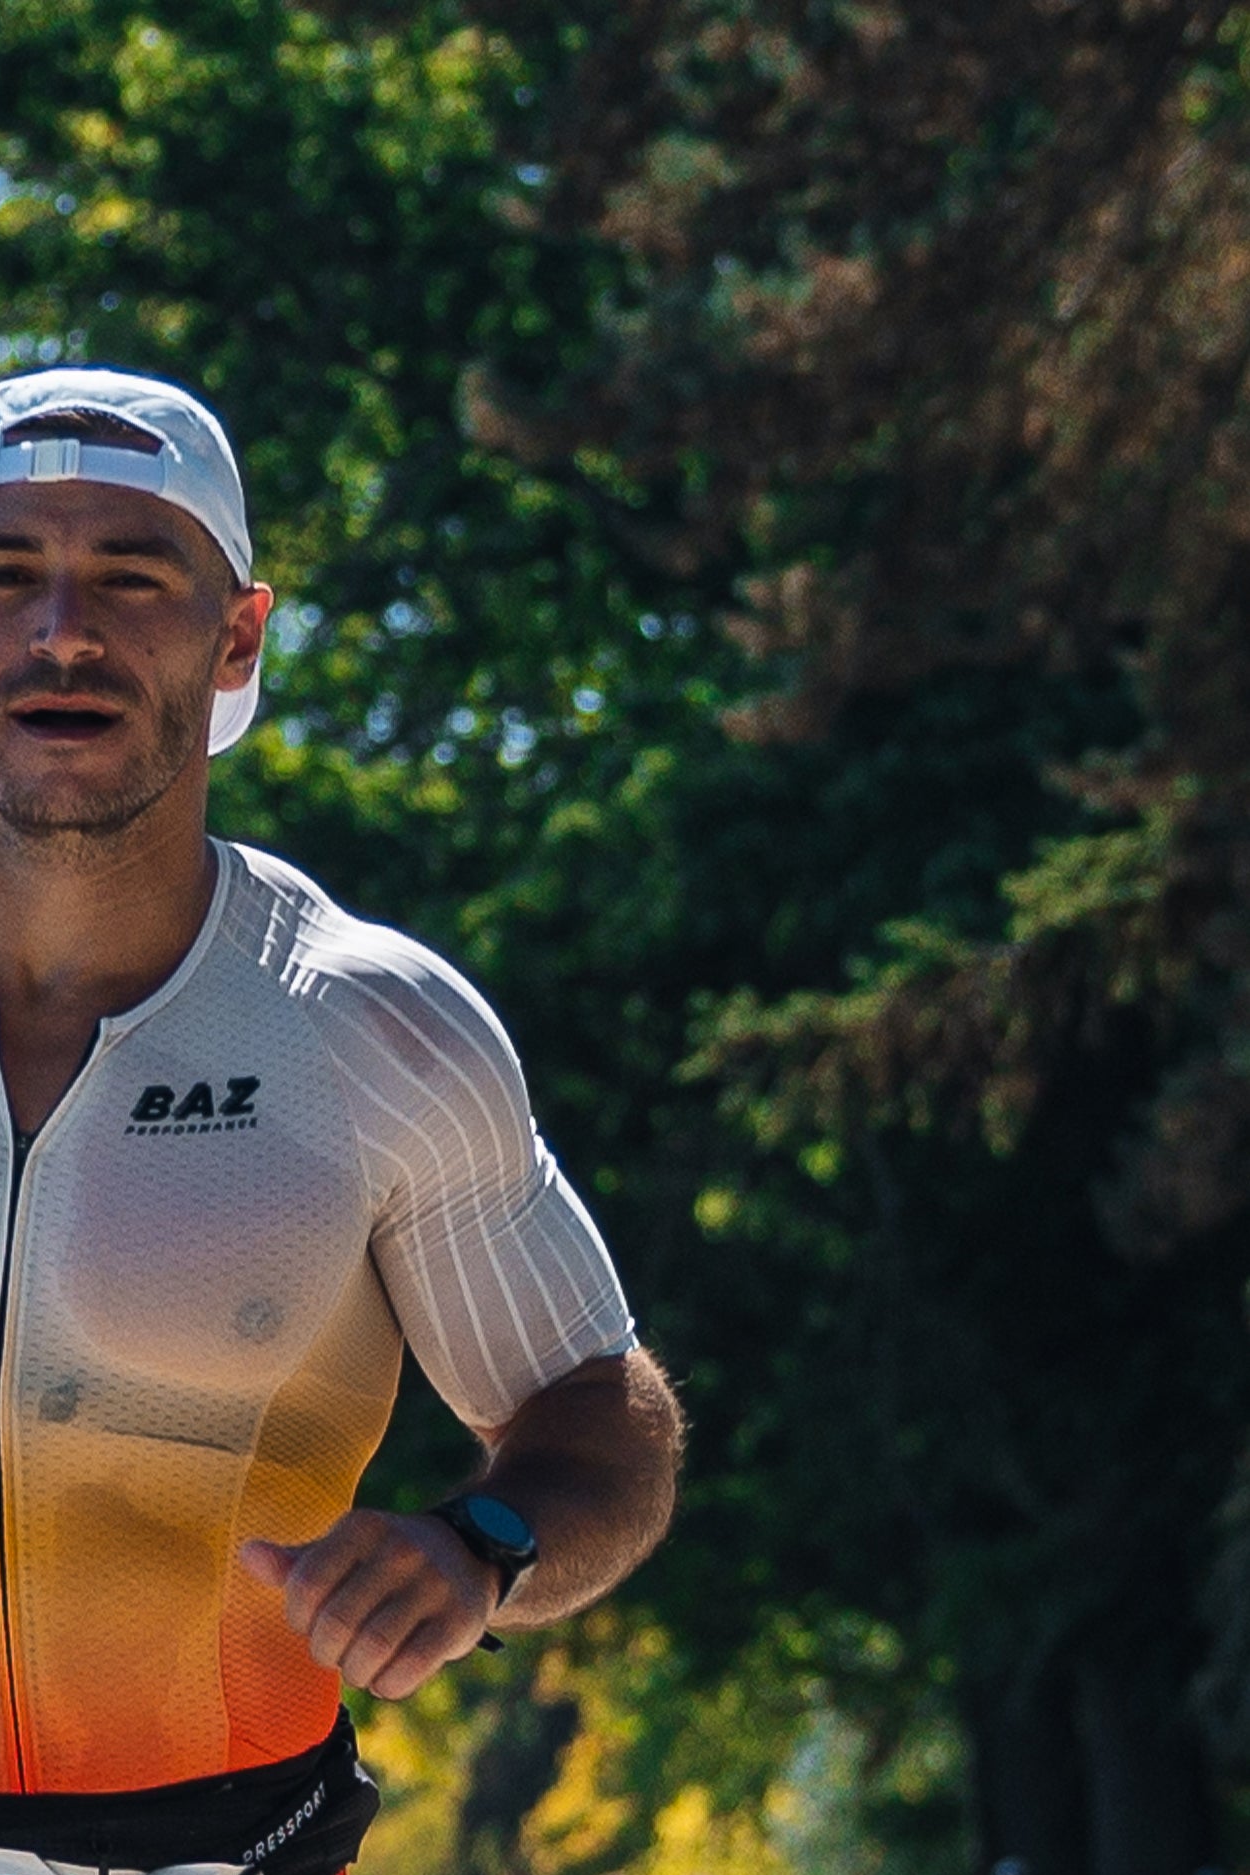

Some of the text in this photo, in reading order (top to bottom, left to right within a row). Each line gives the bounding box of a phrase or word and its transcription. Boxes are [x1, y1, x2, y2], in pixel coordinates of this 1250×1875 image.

[130, 1076, 261, 1122] BAZ
[124, 1117, 258, 1136] PERFORMANCE
[242, 1780, 326, 1868] PRESSPORT
